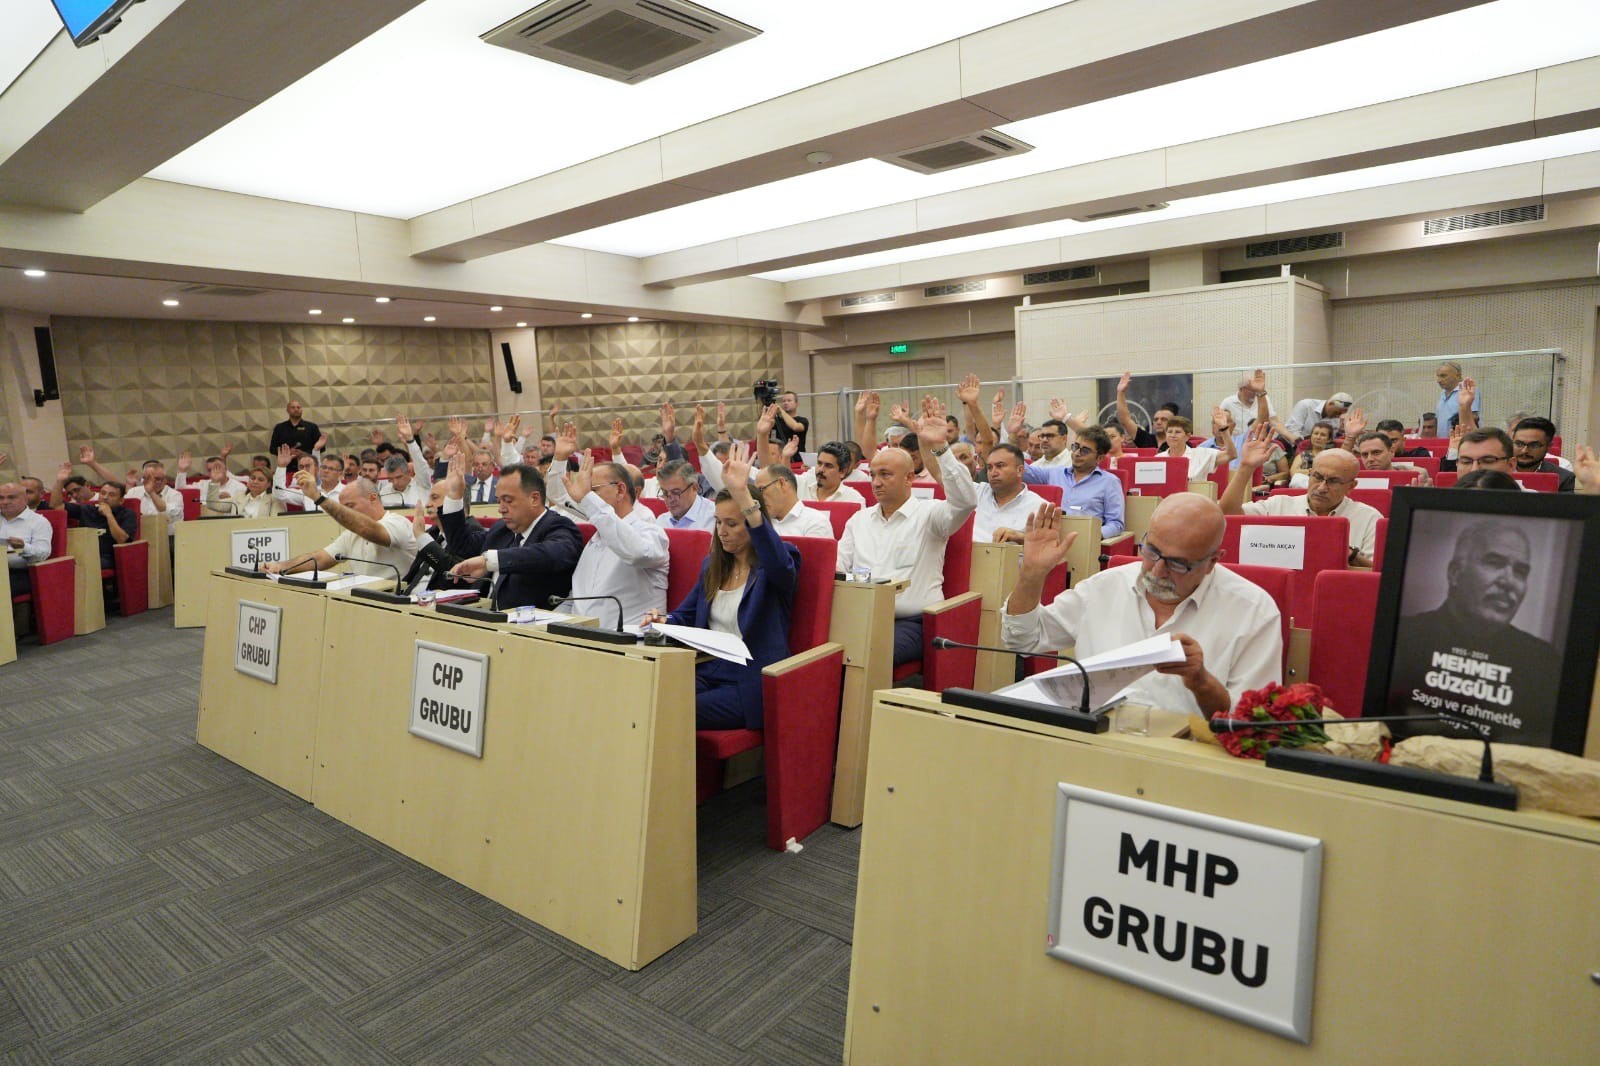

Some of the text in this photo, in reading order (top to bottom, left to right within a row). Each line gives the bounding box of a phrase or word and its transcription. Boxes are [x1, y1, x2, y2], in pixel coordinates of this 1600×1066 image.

[247, 536, 272, 549] CHP
[248, 615, 267, 636] CHP
[241, 642, 270, 667] GRUBU
[1432, 652, 1512, 683] MEHMET
[432, 662, 463, 690] CHP
[1425, 671, 1513, 706] GÜZGÜLÜ
[420, 697, 471, 733] GRUBU
[1412, 689, 1443, 708] Saygı
[1444, 698, 1460, 712] ve
[1461, 704, 1522, 729] rahmetle
[1118, 832, 1239, 898] MHP
[1083, 896, 1269, 988] GRUBU
